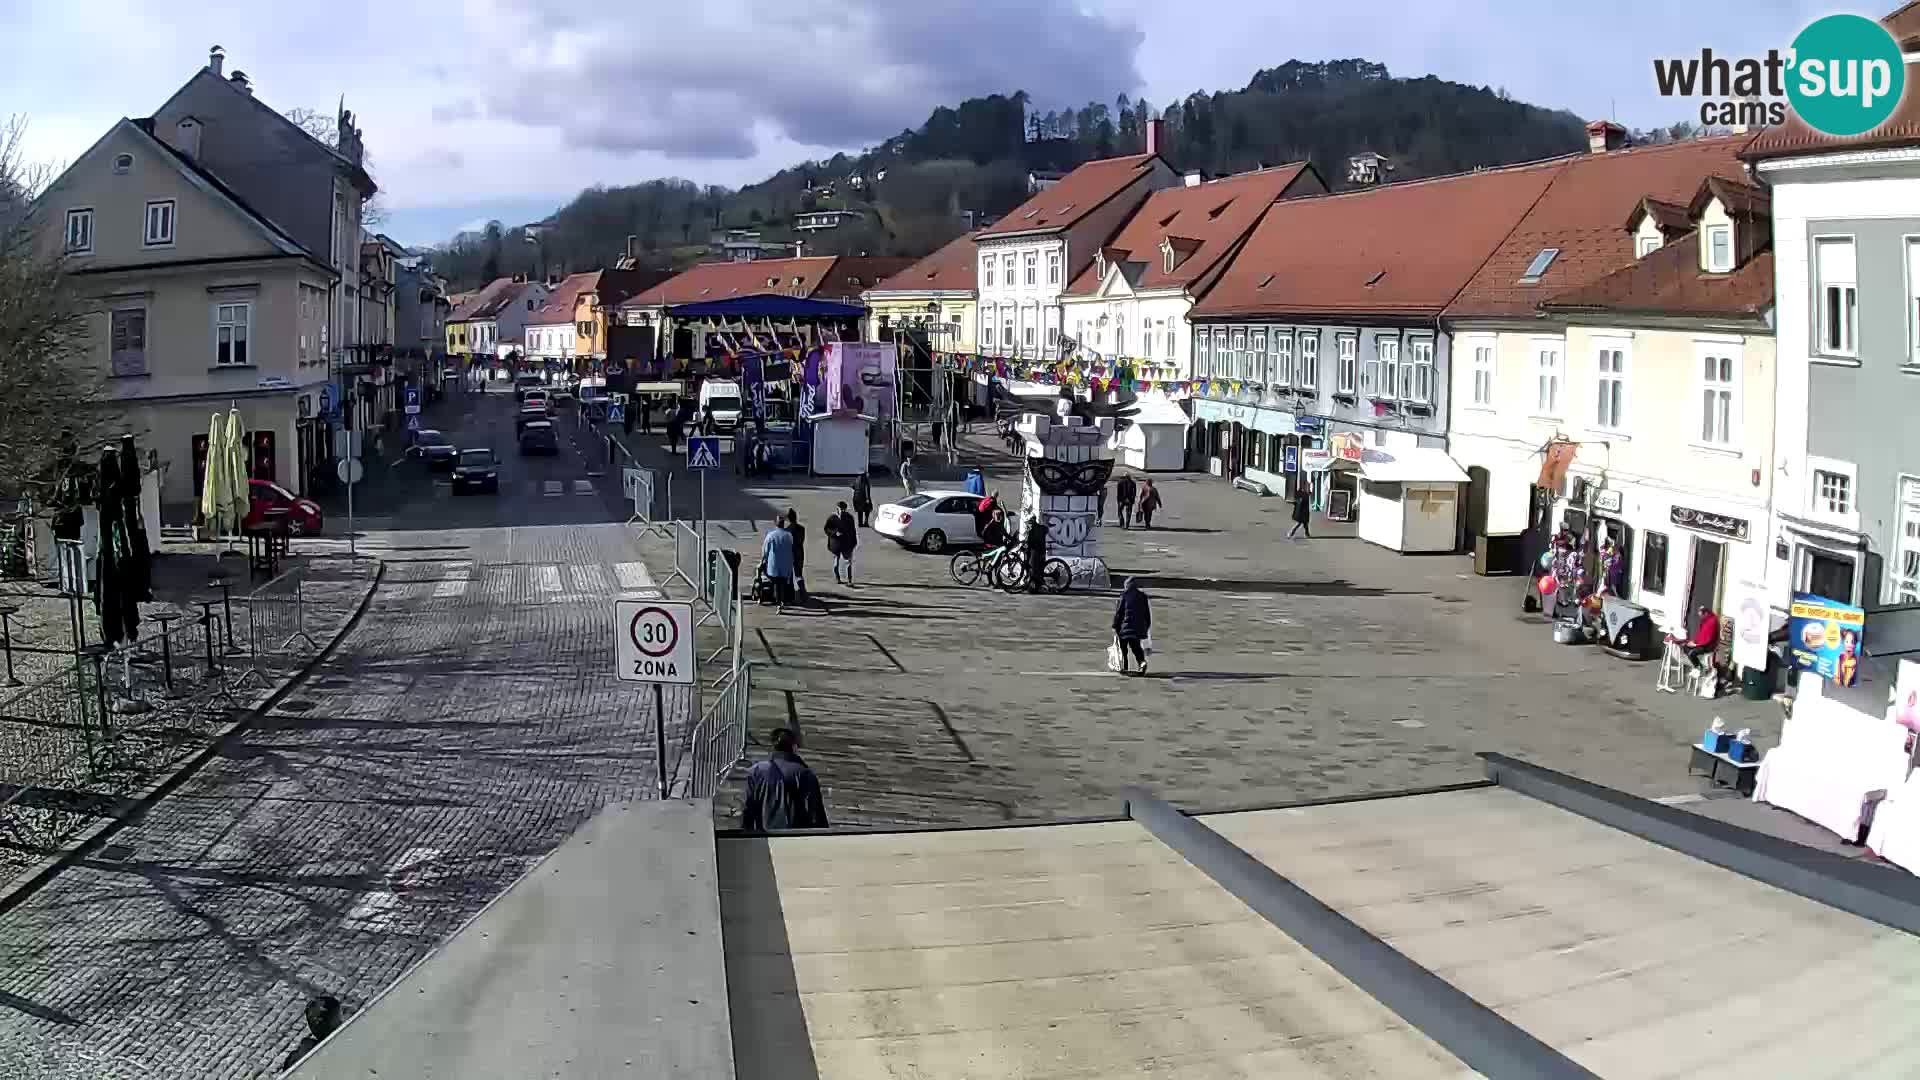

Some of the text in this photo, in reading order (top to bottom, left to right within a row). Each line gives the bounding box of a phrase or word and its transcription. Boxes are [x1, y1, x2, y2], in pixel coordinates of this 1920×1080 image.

[408, 391, 416, 402] P
[1048, 517, 1088, 545] 200
[643, 623, 667, 644] 30
[633, 660, 678, 677] ZONA
